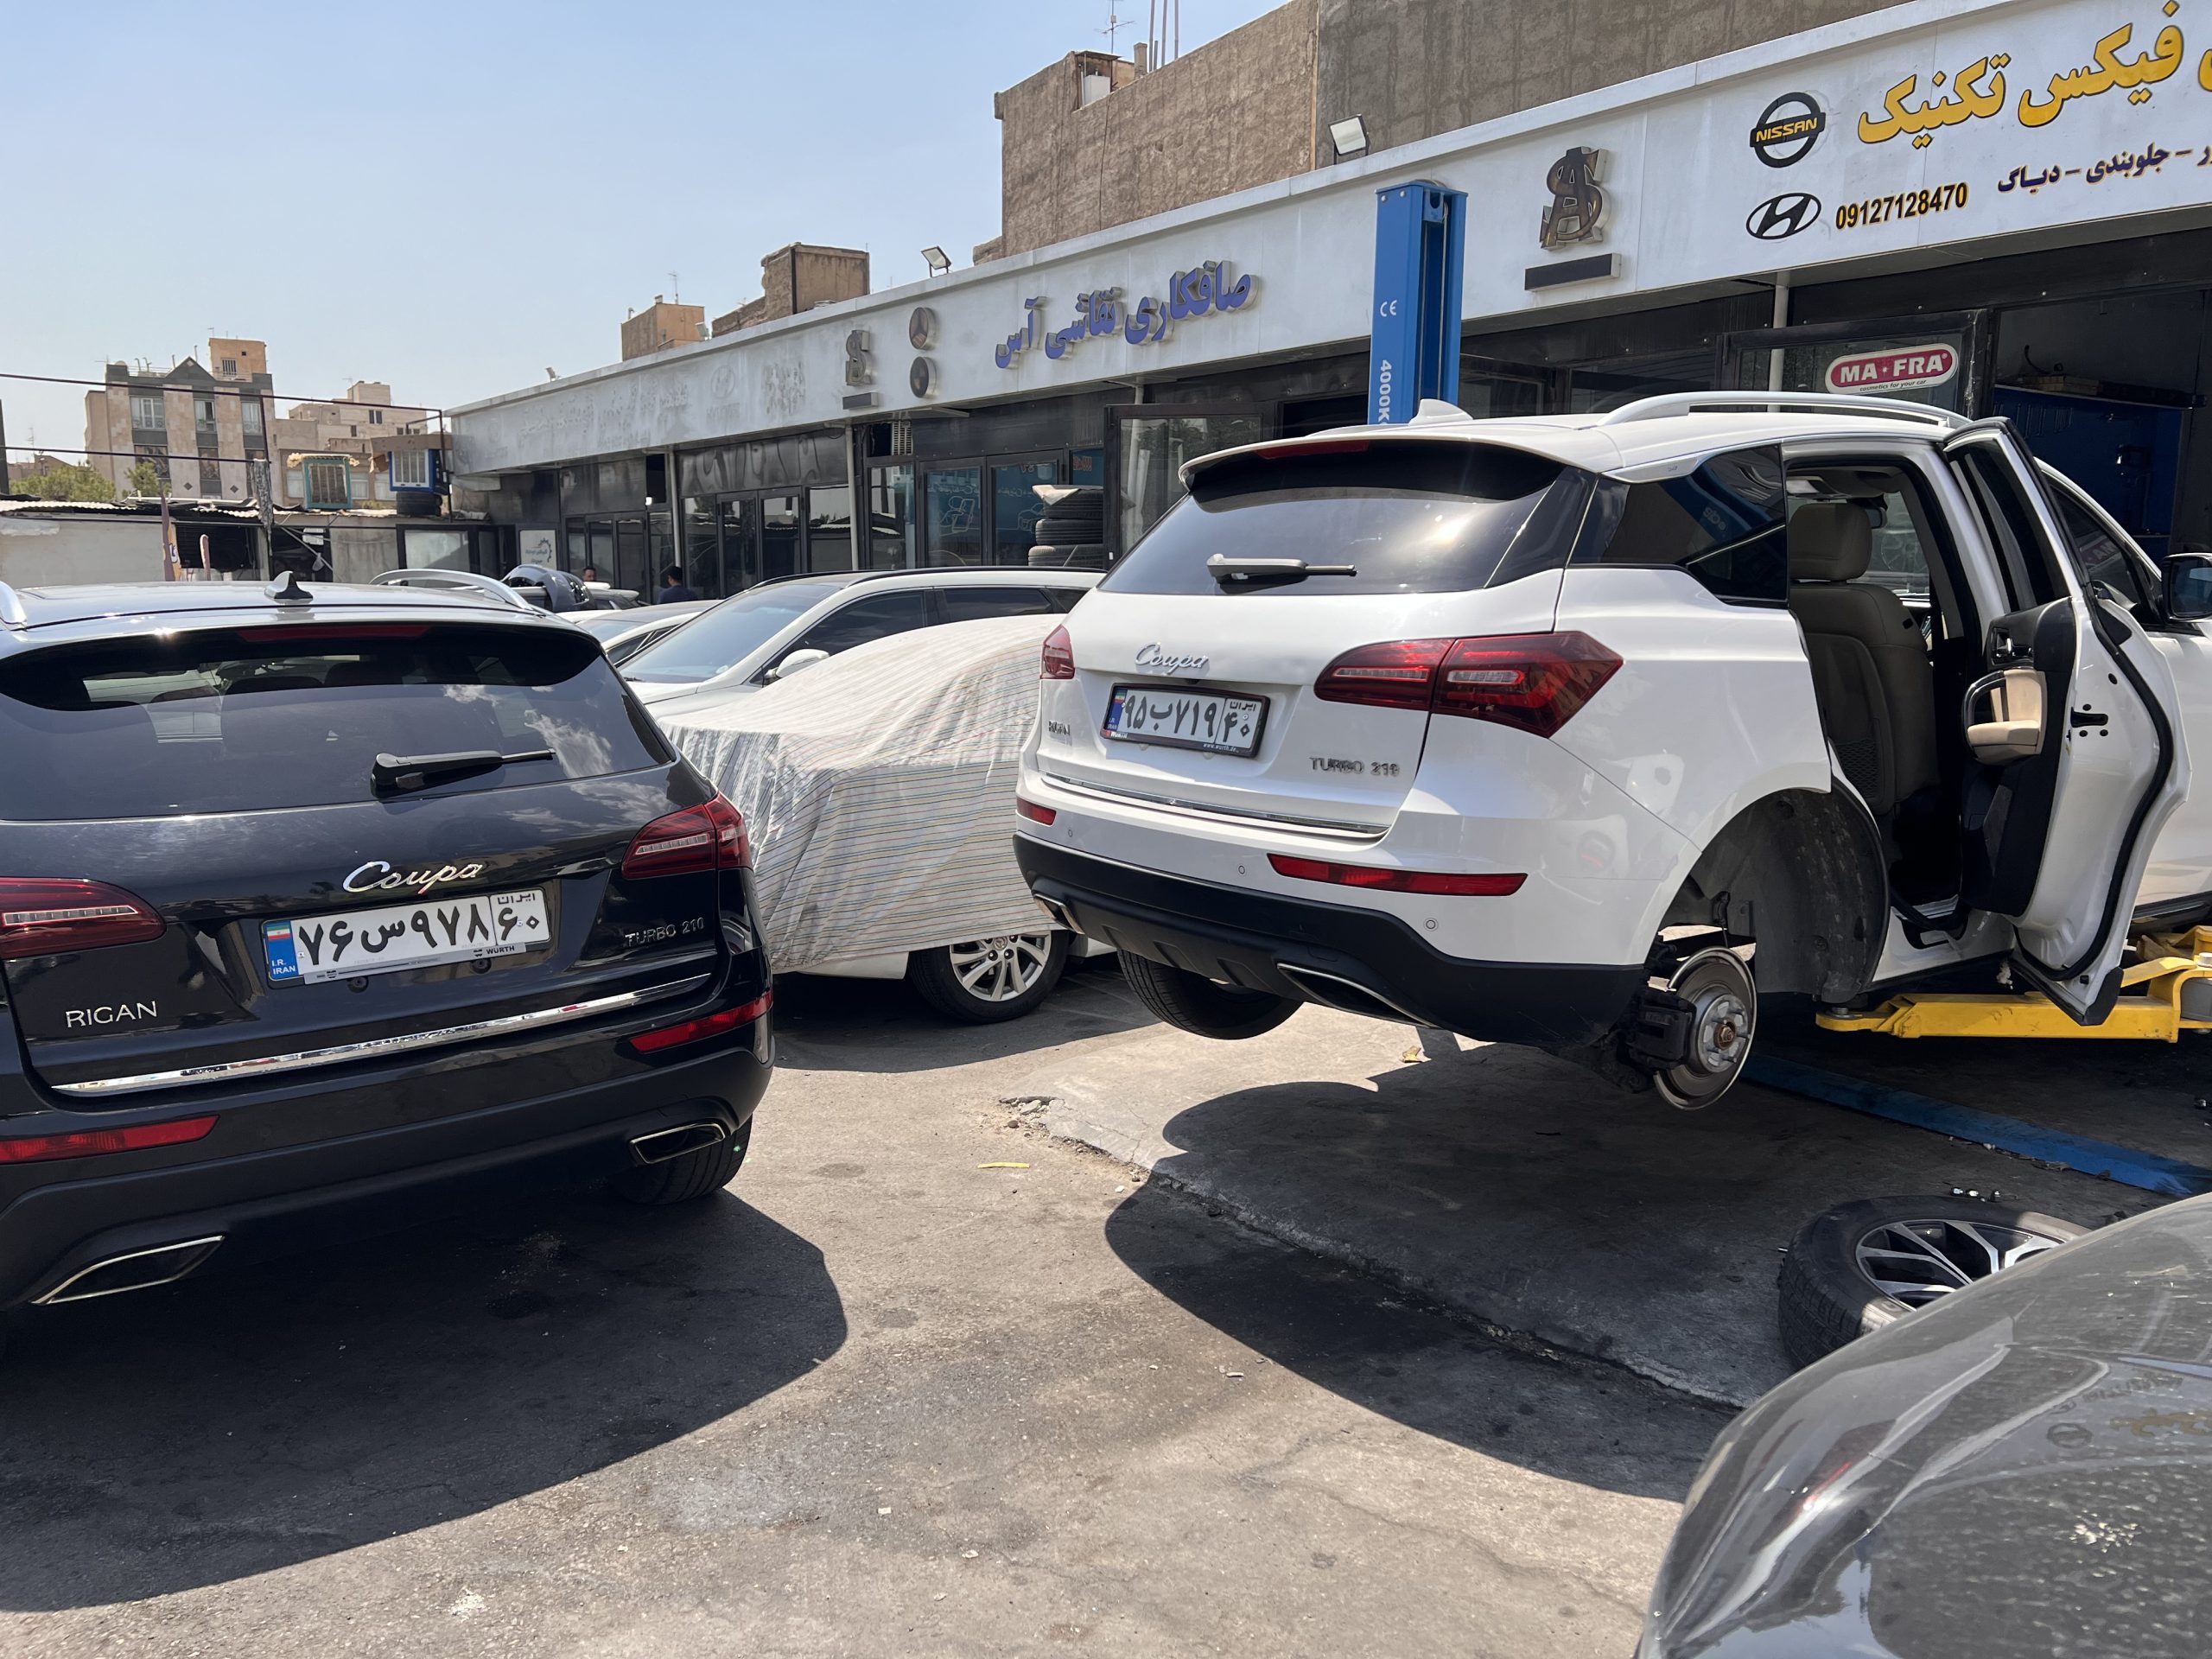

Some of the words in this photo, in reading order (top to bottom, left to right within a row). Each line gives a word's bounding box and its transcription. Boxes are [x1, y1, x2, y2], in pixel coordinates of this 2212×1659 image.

[2018, 0, 2184, 128] فیکس
[1858, 53, 2012, 149] تکنیک
[1755, 117, 1818, 143] NISSAN
[1835, 181, 1969, 231] 09127128470
[1124, 260, 1258, 345] صافکاری
[1377, 359, 1393, 424] 4000K
[343, 861, 483, 894] Coupa
[498, 893, 536, 905] ایران
[625, 924, 677, 947] TURBO
[682, 917, 705, 934] 210
[273, 965, 296, 975] IRAN
[66, 1001, 157, 1028] RIGAN
